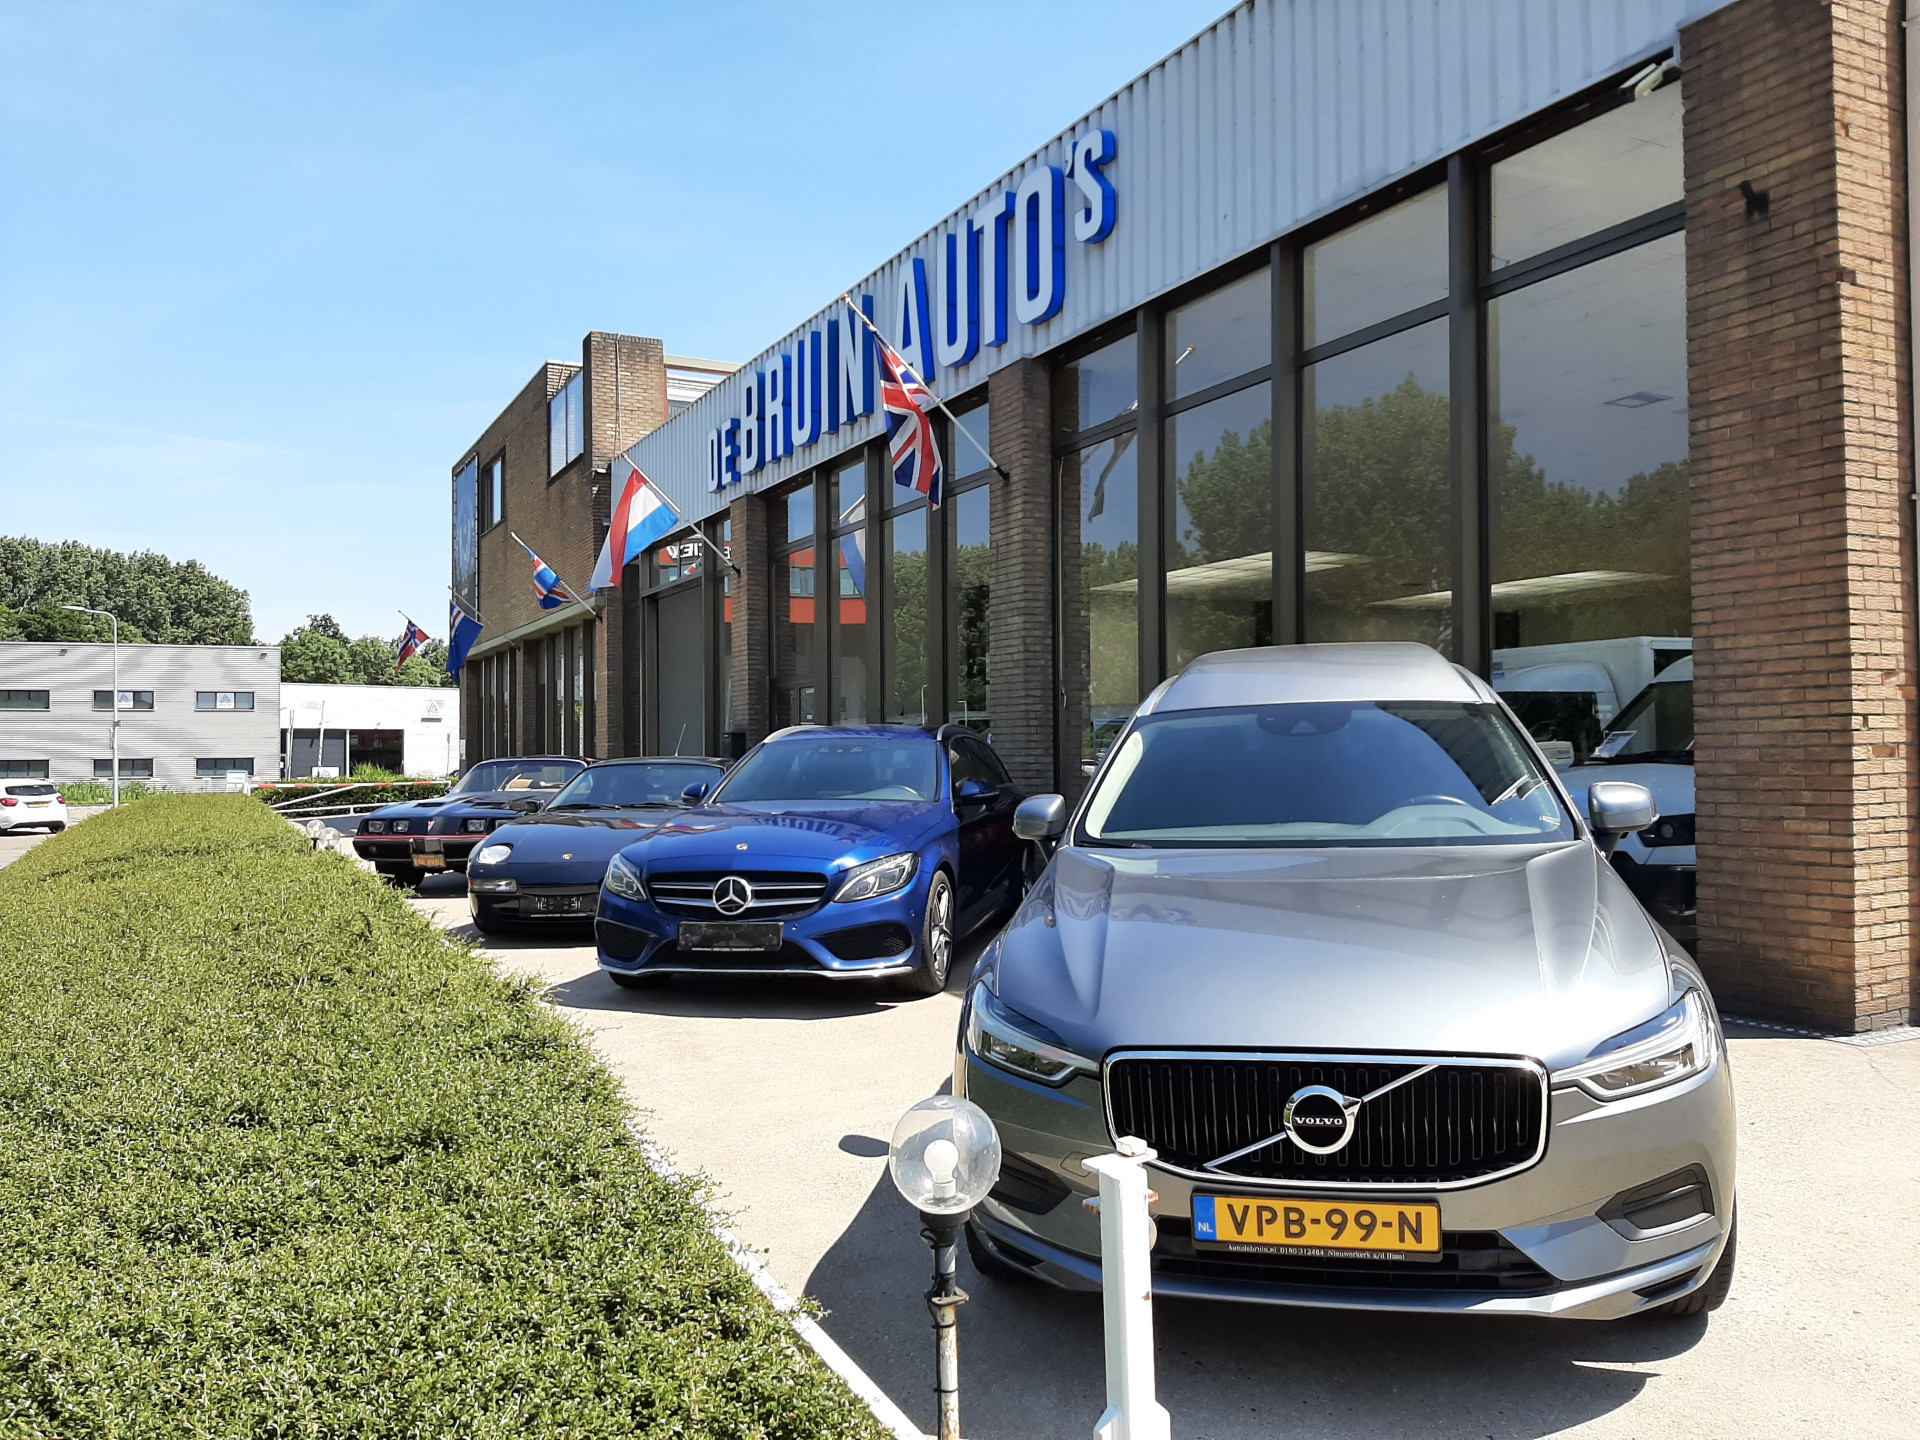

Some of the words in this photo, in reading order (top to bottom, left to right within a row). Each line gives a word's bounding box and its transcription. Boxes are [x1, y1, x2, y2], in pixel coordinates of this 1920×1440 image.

[707, 418, 740, 493] DE
[740, 295, 873, 475] BRUIN
[895, 128, 1116, 384] AUTO'S
[1294, 1117, 1344, 1126] VOLVO
[1198, 1222, 1213, 1233] NL
[1227, 1203, 1423, 1244] VPB-99-N
